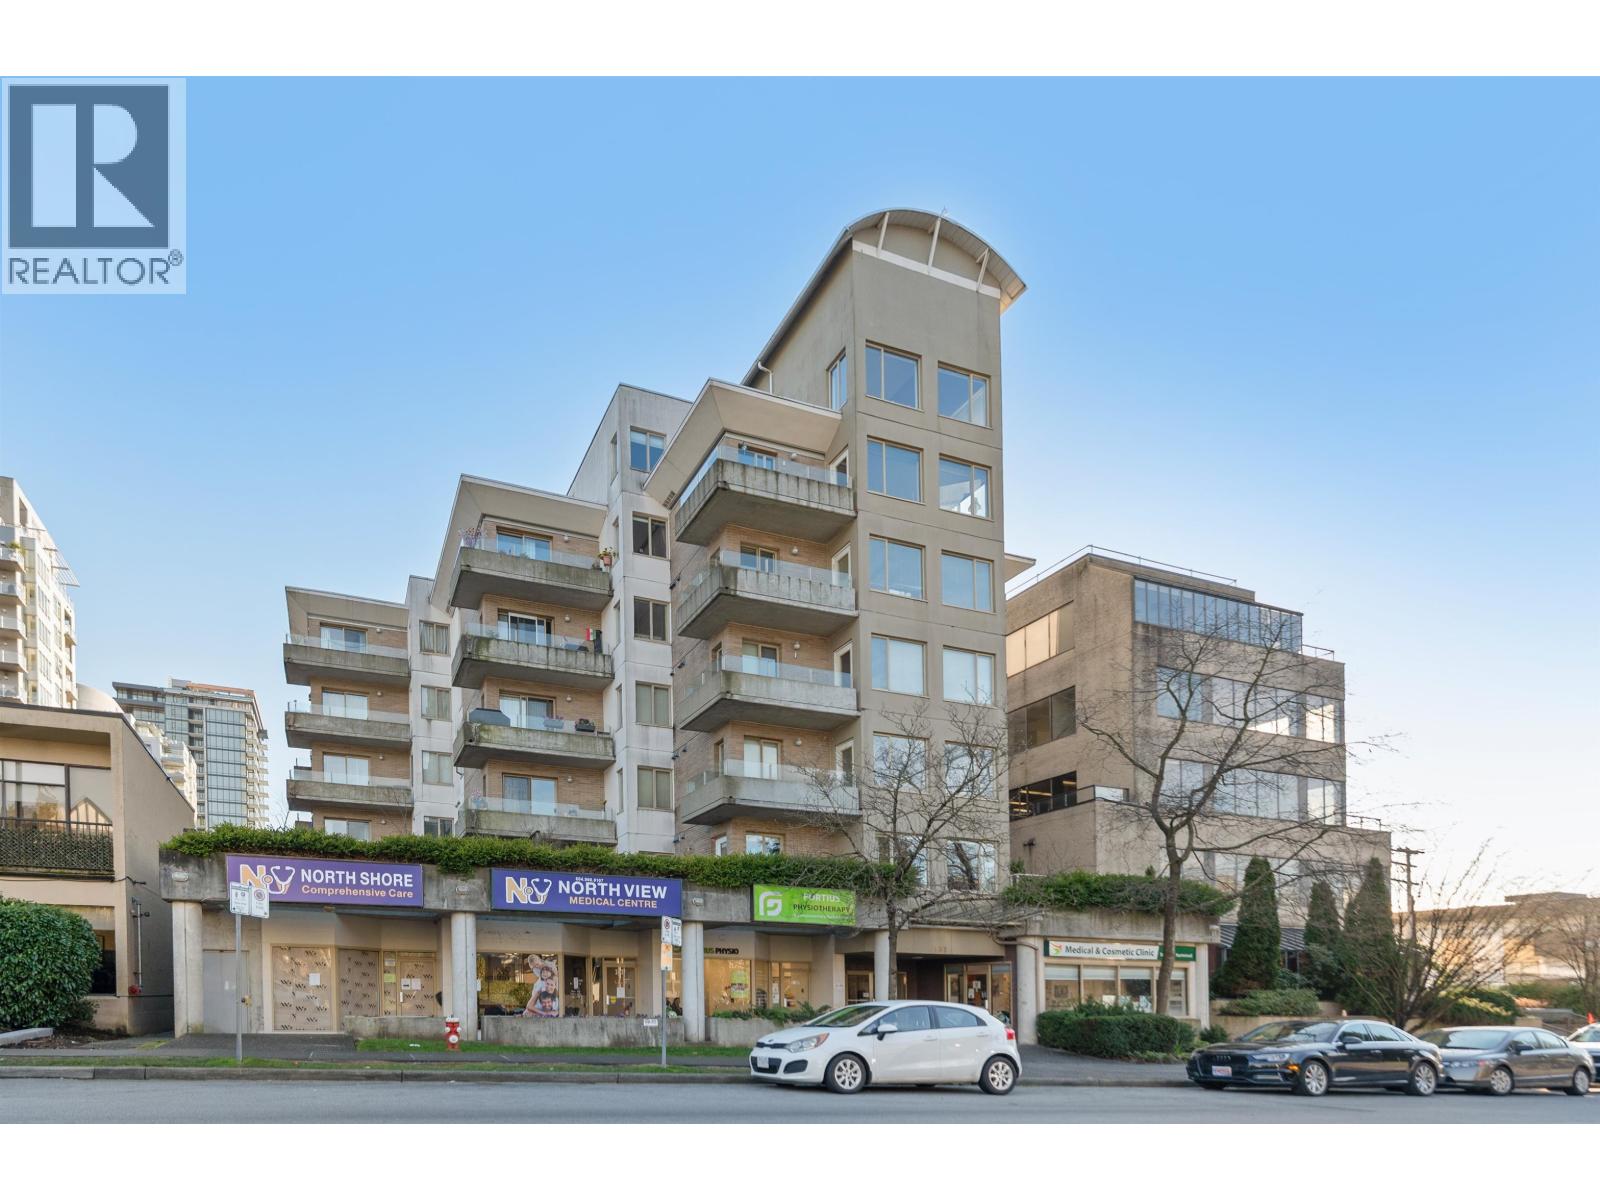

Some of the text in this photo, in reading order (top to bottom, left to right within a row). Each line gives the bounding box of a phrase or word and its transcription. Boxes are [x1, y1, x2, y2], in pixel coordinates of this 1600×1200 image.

[301, 868, 413, 887] NORTH SHORE
[301, 885, 413, 898] Comprehensive Care
[558, 880, 668, 899] NORTH VIEW
[569, 896, 657, 908] MEDICAL CENTRE
[793, 903, 850, 913] PHYSIOTHERAPY
[715, 947, 739, 955] PHYSIO
[1065, 945, 1094, 955] Medical
[1095, 946, 1101, 955] &
[1102, 947, 1134, 956] Cosmetic
[1135, 948, 1154, 957] Clinic
